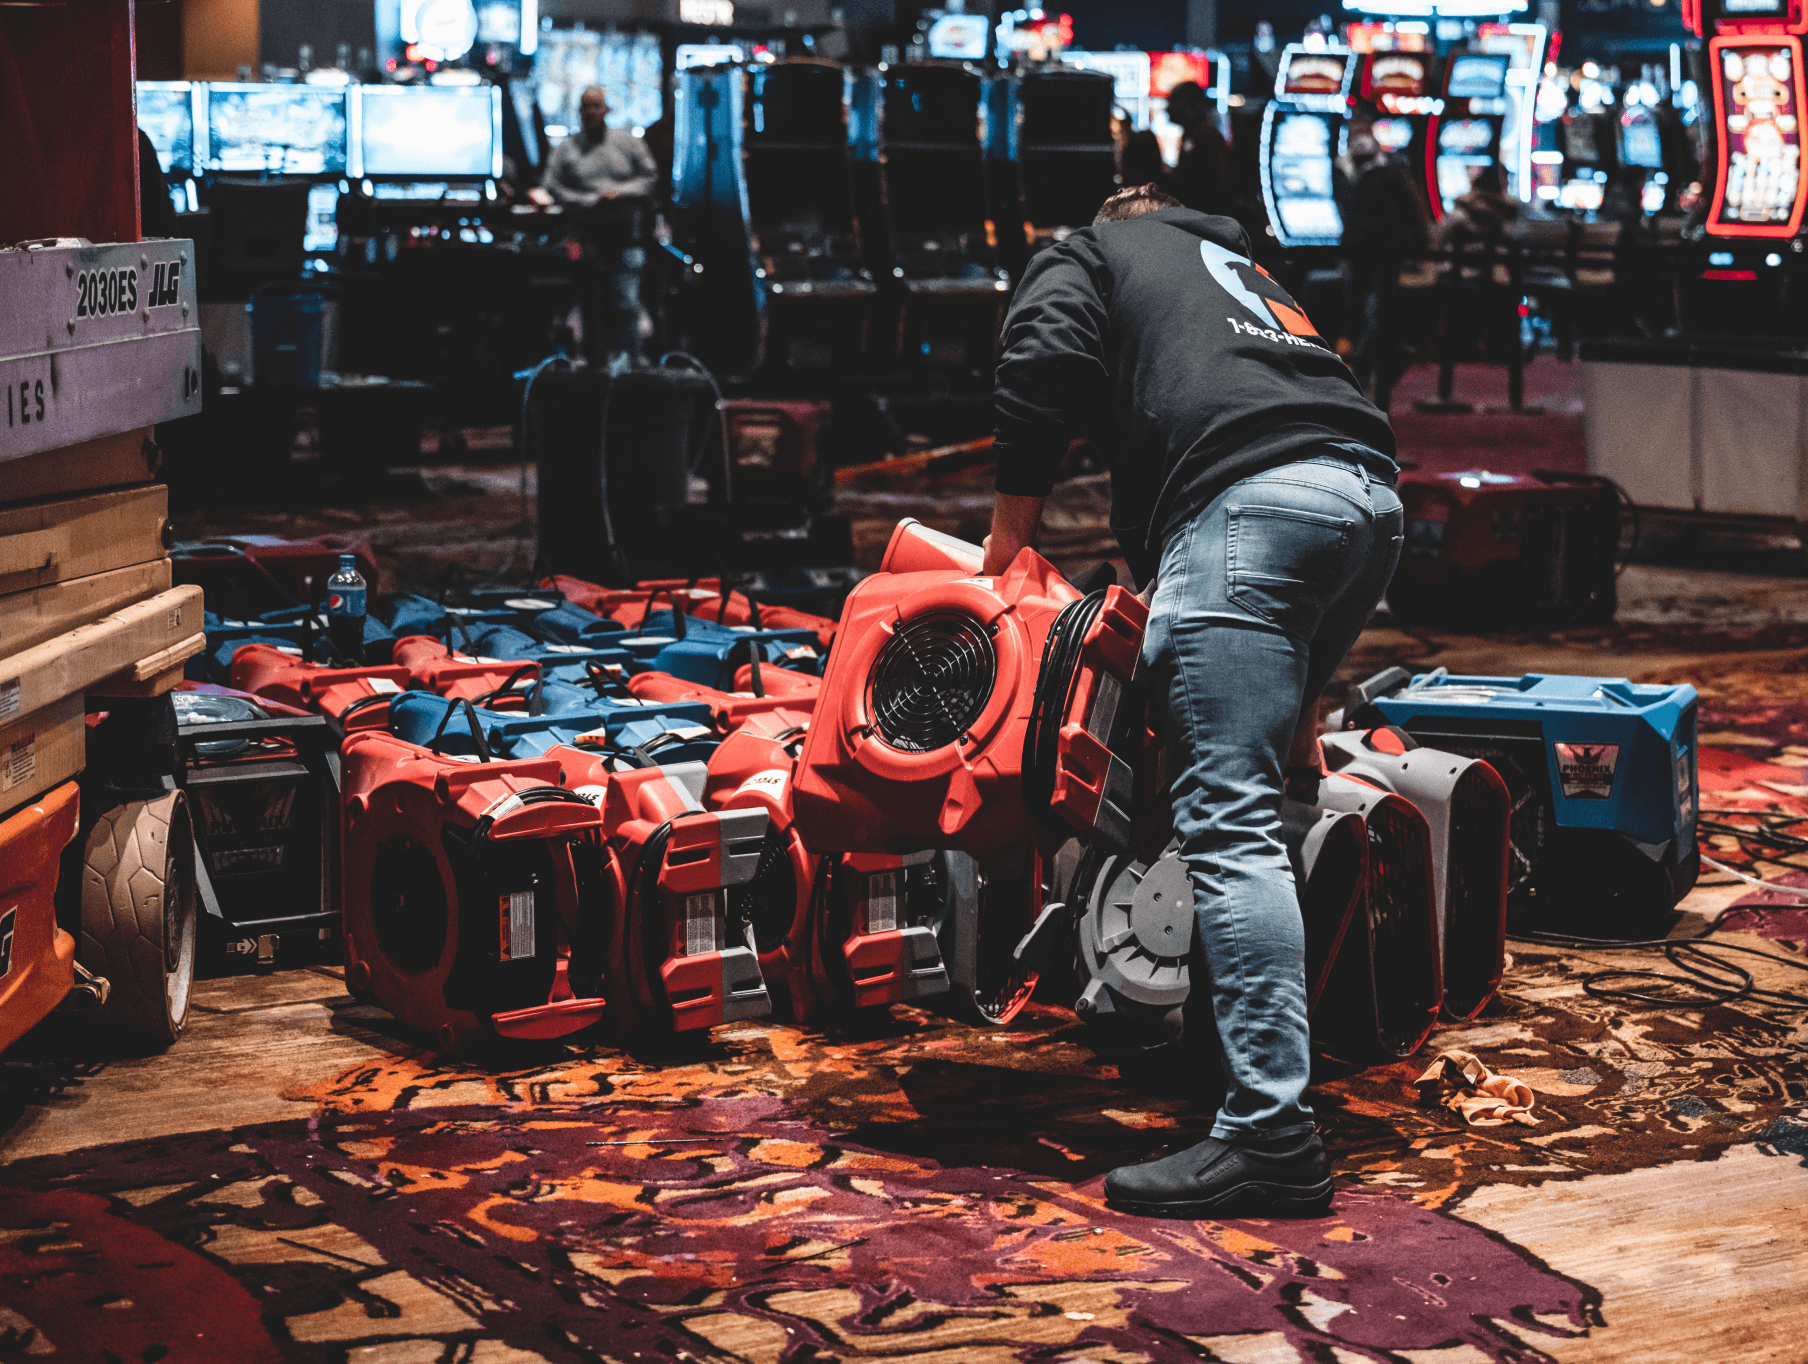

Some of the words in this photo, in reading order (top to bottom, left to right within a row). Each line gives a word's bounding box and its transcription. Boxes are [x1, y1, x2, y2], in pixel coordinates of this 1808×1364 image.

[76, 268, 138, 319] 2030ES
[147, 261, 180, 308] JLG
[7, 379, 45, 428] IES
[1562, 764, 1610, 773] PHOENIX
